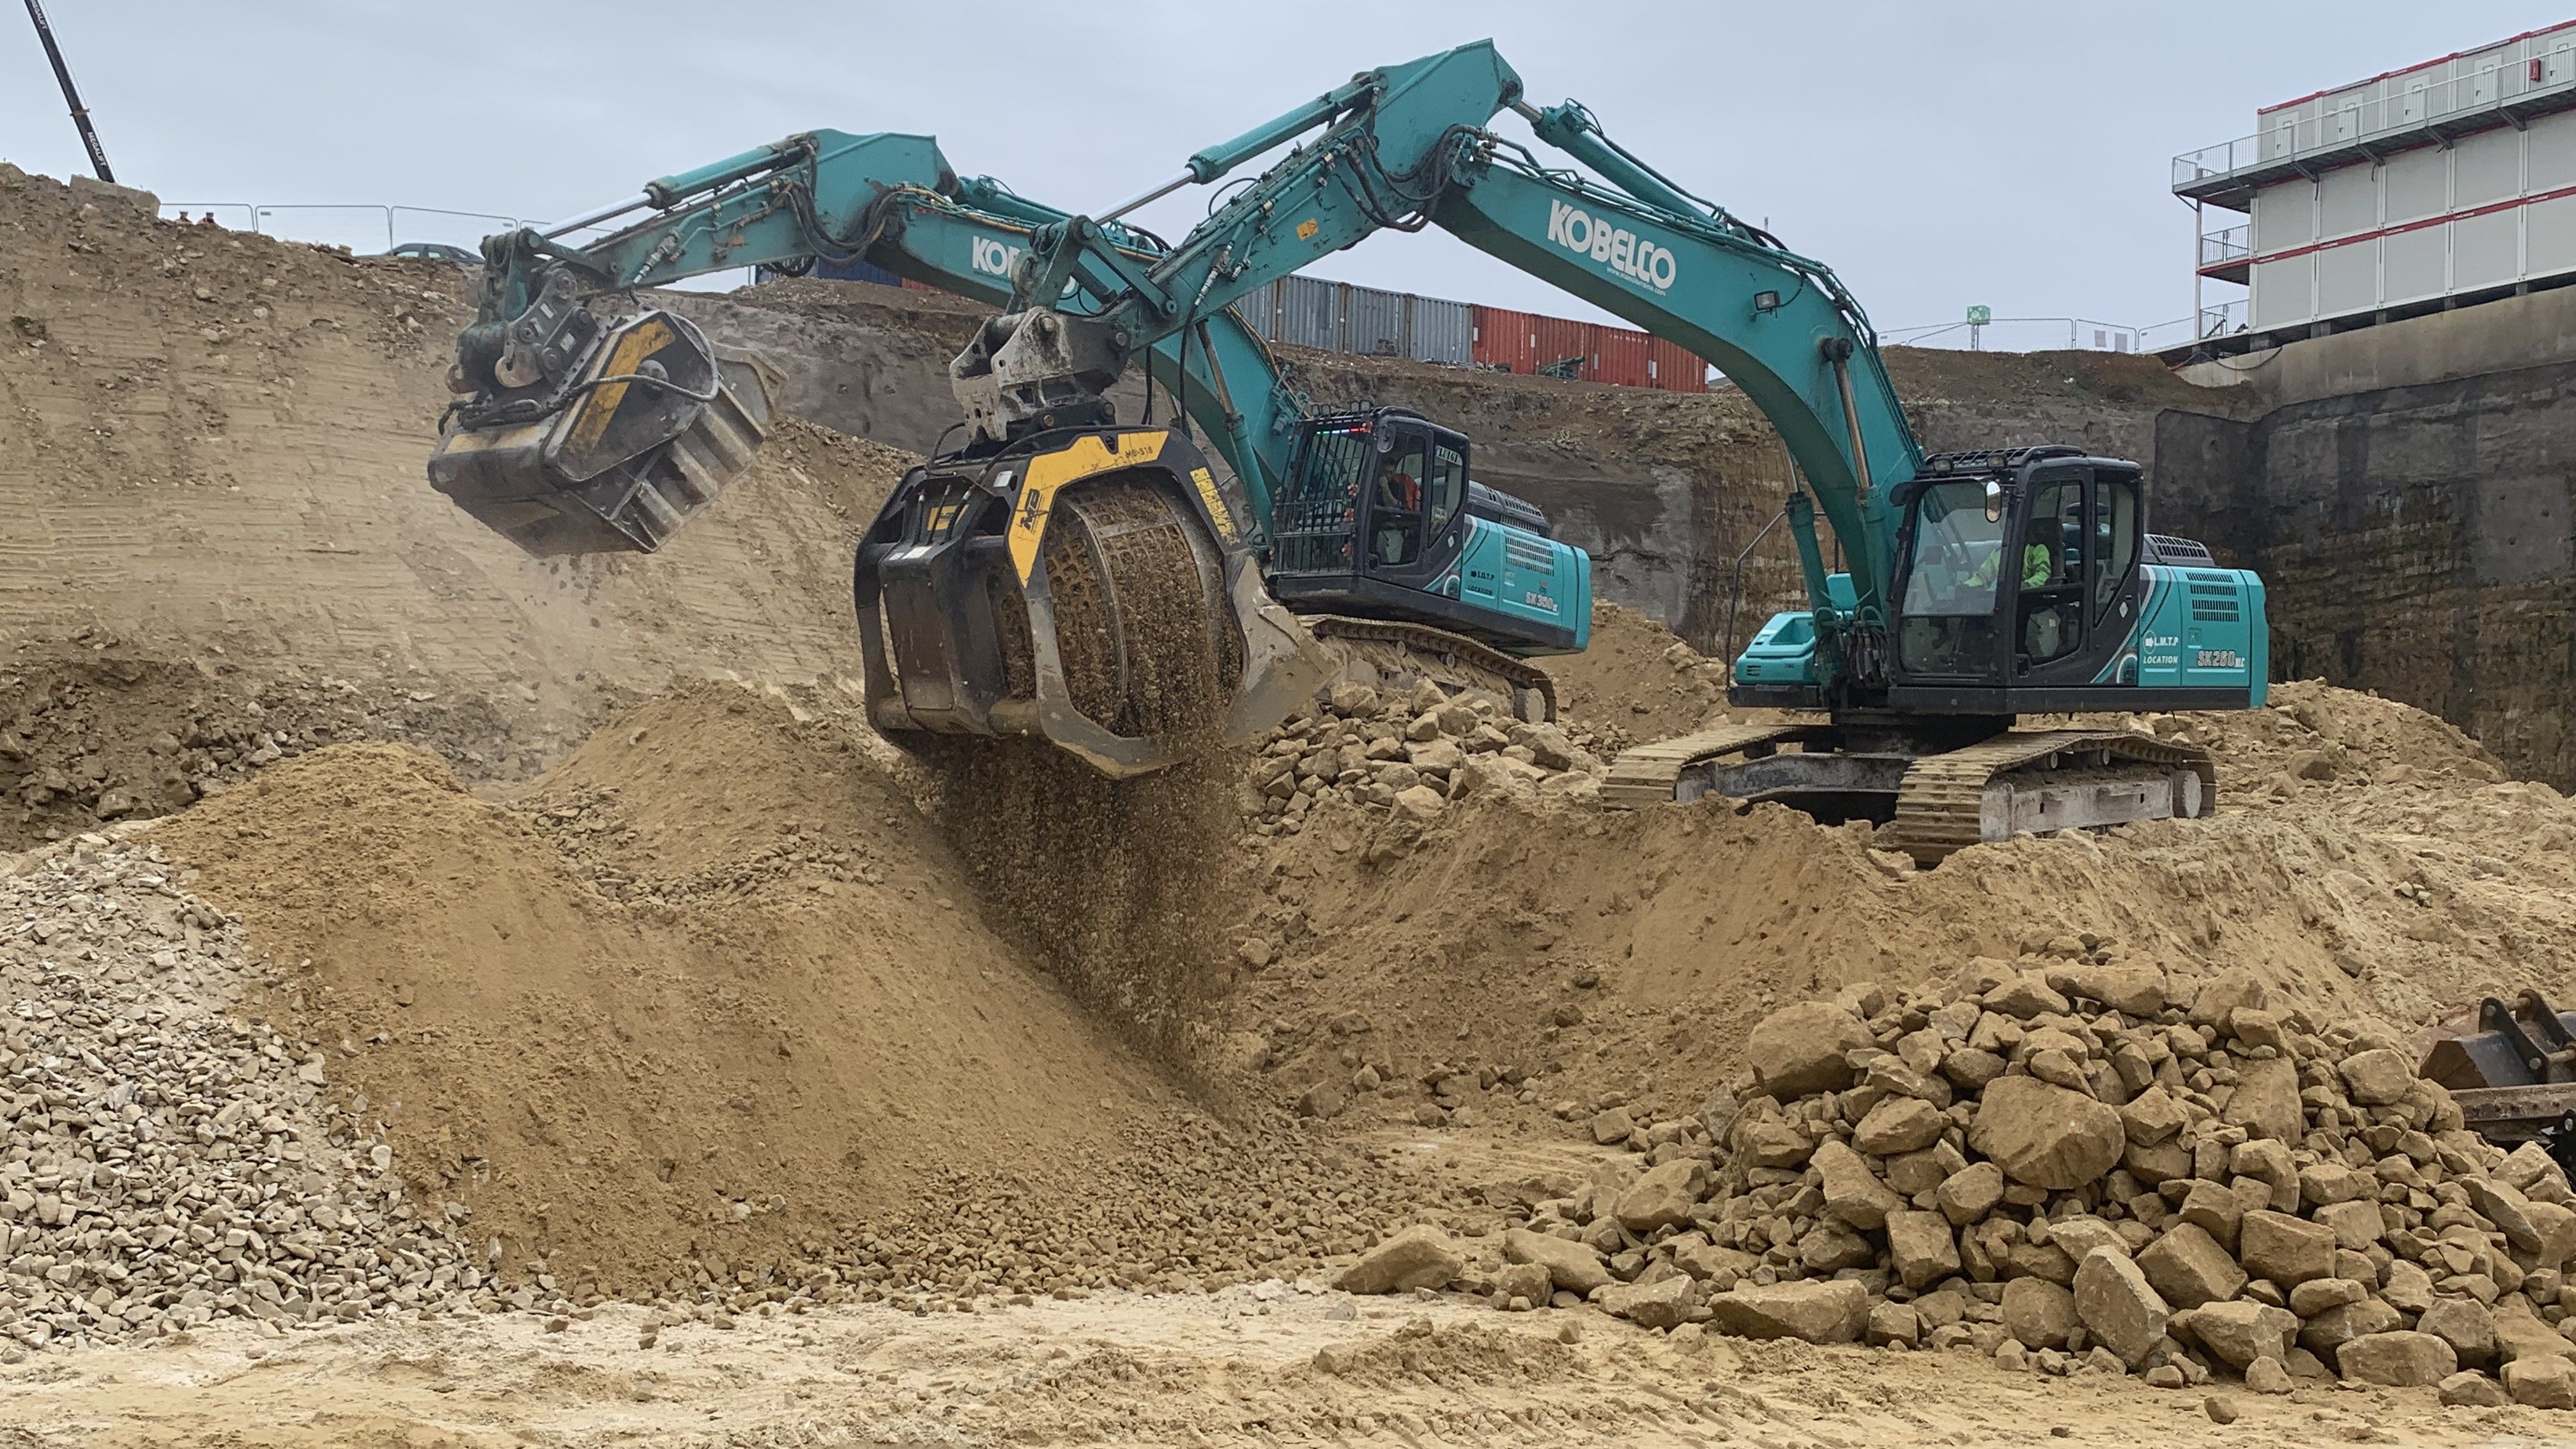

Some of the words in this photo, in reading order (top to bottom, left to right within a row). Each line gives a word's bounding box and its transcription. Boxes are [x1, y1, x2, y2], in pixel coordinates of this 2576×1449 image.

[87, 131, 107, 166] MEGALIFT
[1547, 197, 1676, 289] KOBELCO
[1438, 447, 1458, 463] LUIGI
[2143, 656, 2179, 664] LOCATION
